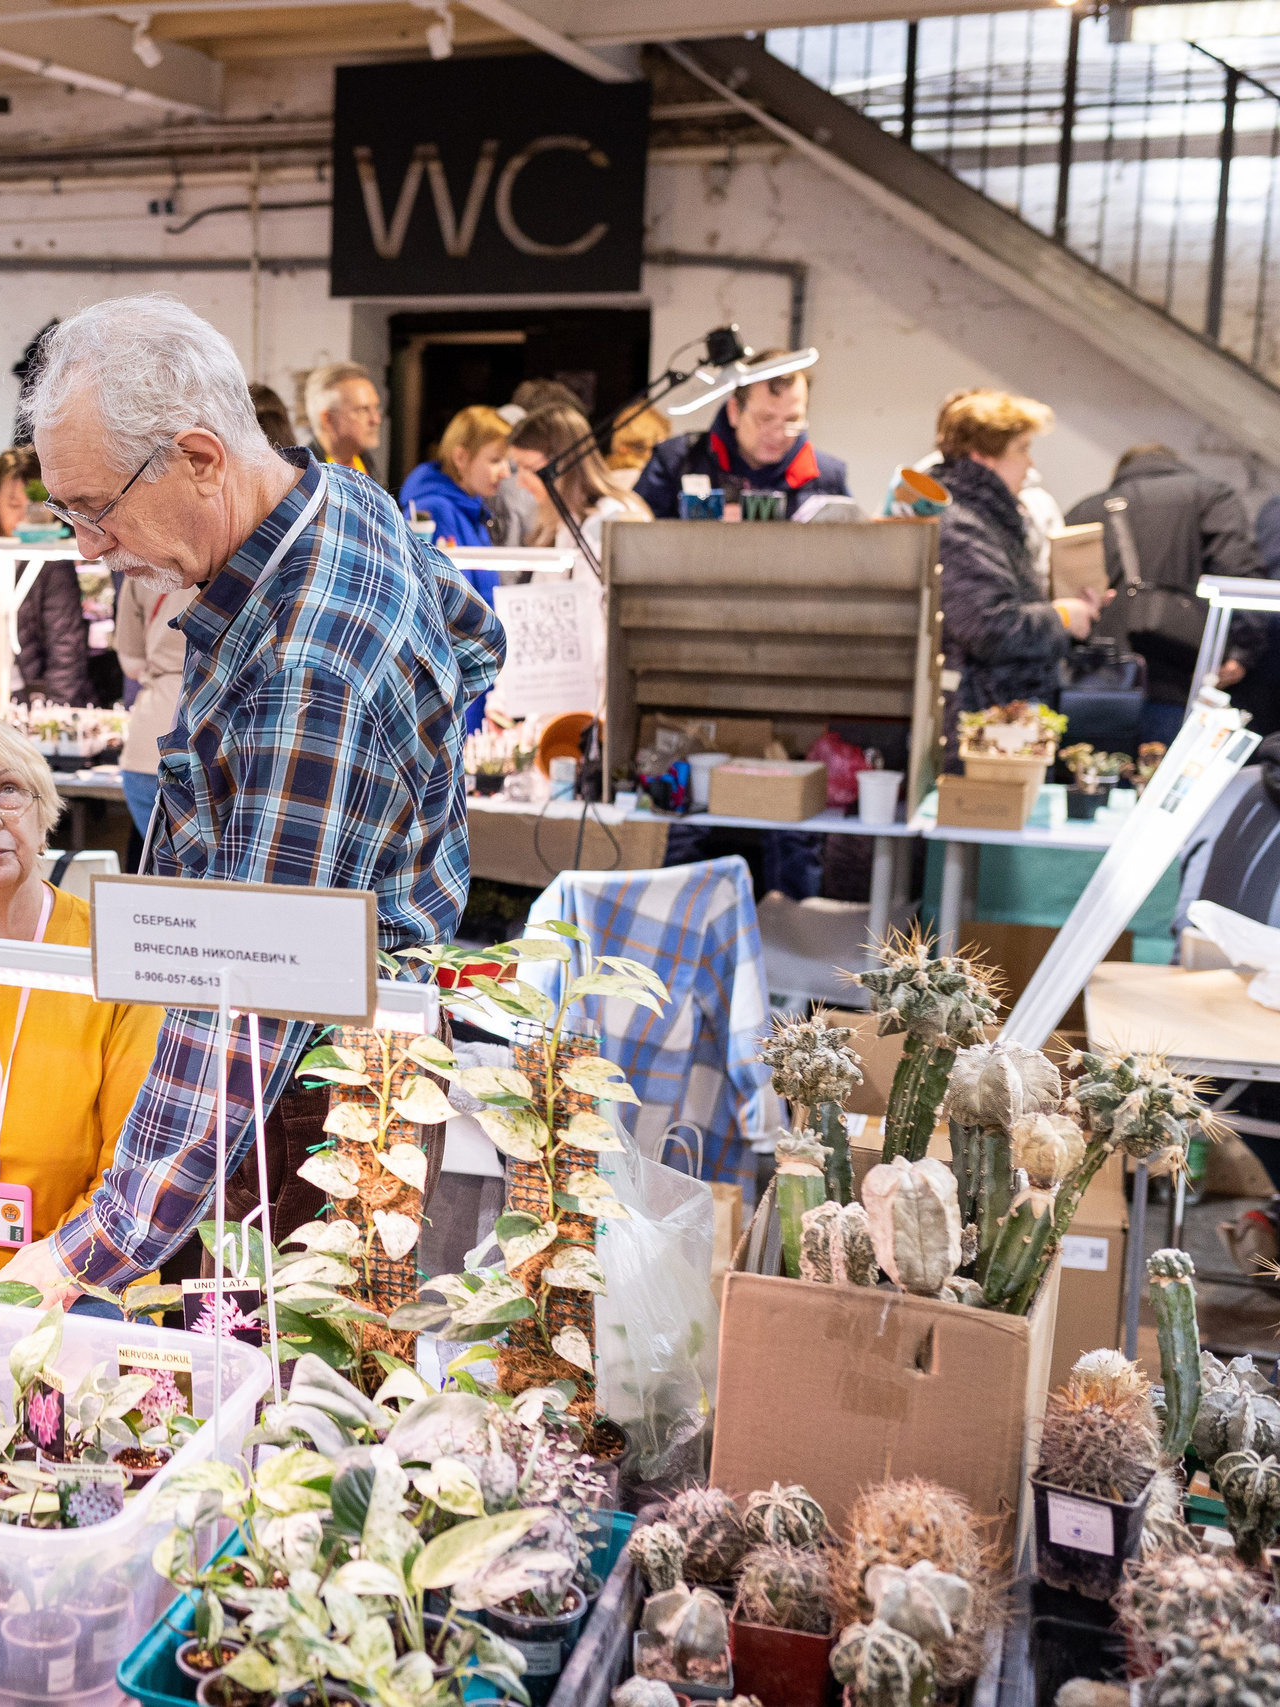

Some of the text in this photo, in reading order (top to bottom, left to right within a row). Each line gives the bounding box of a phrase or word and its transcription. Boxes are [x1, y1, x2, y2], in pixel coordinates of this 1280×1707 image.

[354, 136, 611, 259] WC
[133, 914, 197, 929] СБЕРБАНК
[134, 942, 300, 965] ВЯЧЕСЛАВ НИКОЛАЕВИЧ К.
[193, 1279, 249, 1289] UNDLATA
[118, 1349, 191, 1364] NERVOSA JOKUL
